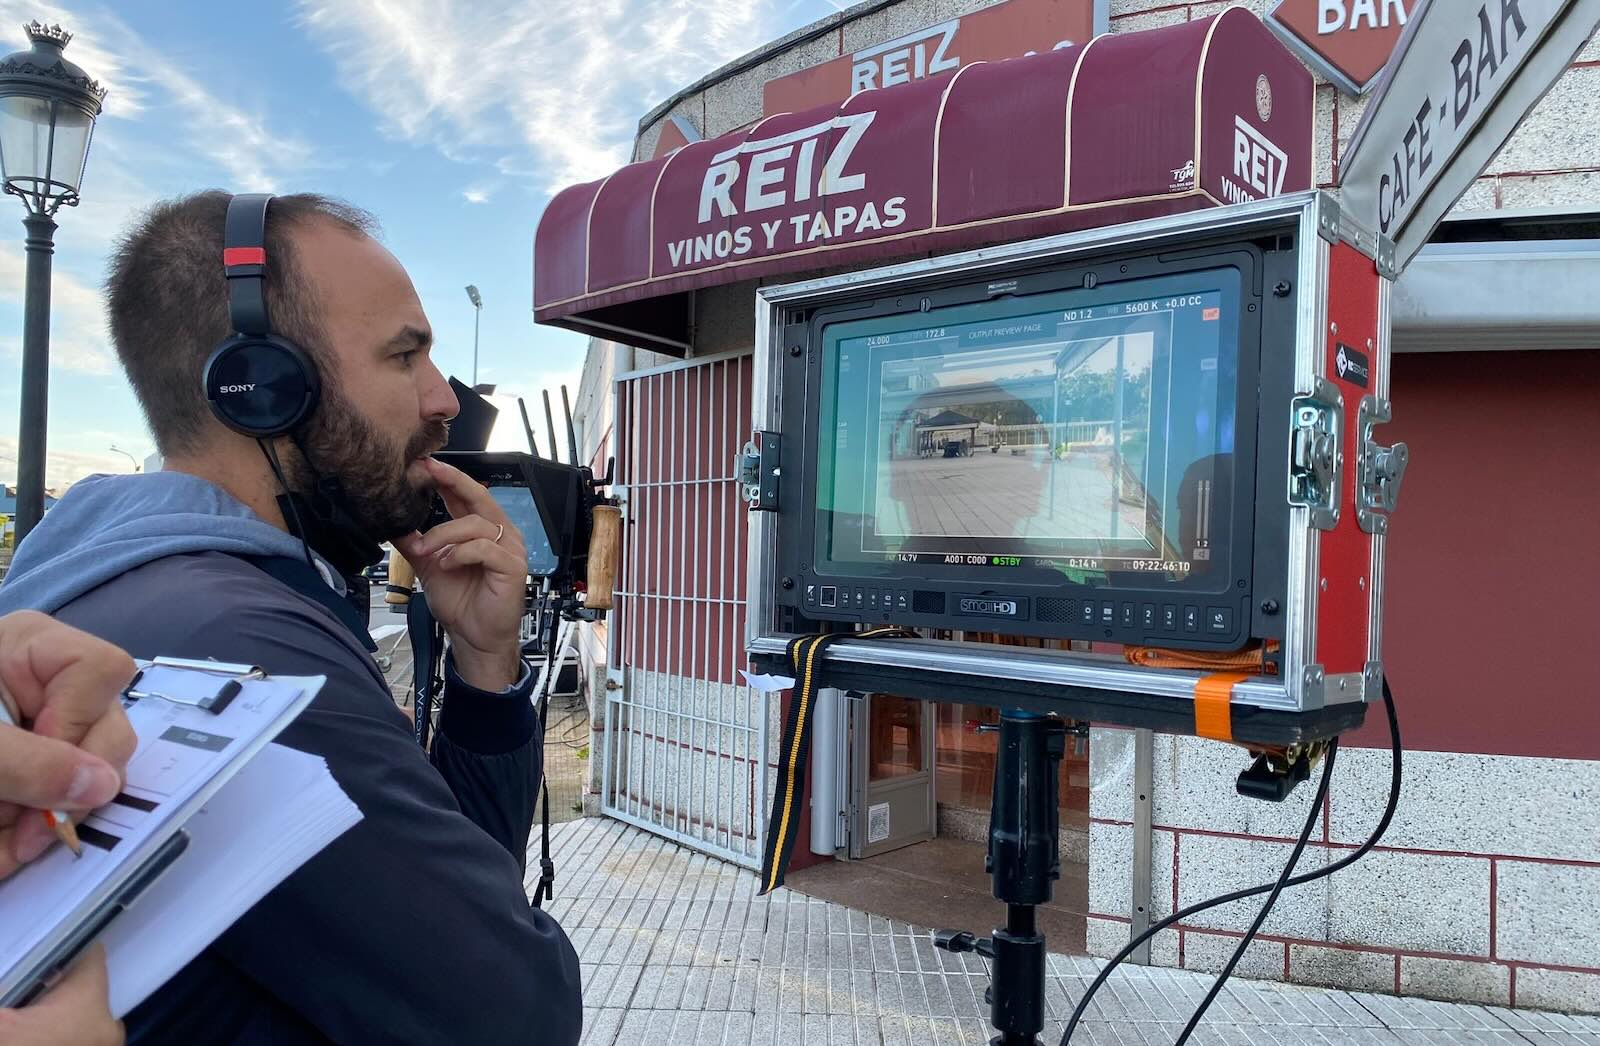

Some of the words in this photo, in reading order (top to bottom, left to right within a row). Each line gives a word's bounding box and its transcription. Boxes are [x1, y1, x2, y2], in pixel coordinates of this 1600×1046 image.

[851, 19, 960, 96] REIZ
[698, 111, 877, 224] REIZ
[1221, 175, 1255, 204] VINO
[667, 226, 752, 267] VINOS
[761, 219, 782, 249] Y
[790, 196, 907, 245] TAPAS
[1064, 312, 1077, 321] ND
[1080, 309, 1093, 319] 1.2
[1125, 302, 1149, 313] 5600
[1151, 301, 1158, 310] K
[1165, 297, 1186, 308] +0.0
[1188, 295, 1202, 305] CC
[925, 328, 945, 338] 172.8
[1024, 323, 1041, 334] PAGE
[219, 384, 256, 394] SONY
[898, 554, 918, 562] 14.7V
[944, 555, 964, 564] A001
[967, 555, 987, 565] C000
[999, 557, 1021, 566] STBY
[1069, 558, 1089, 568] 0:14
[1132, 560, 1190, 572] 09:22:46:10
[1145, 610, 1151, 618] 2
[1166, 611, 1172, 619] 3
[1188, 612, 1194, 620] 4
